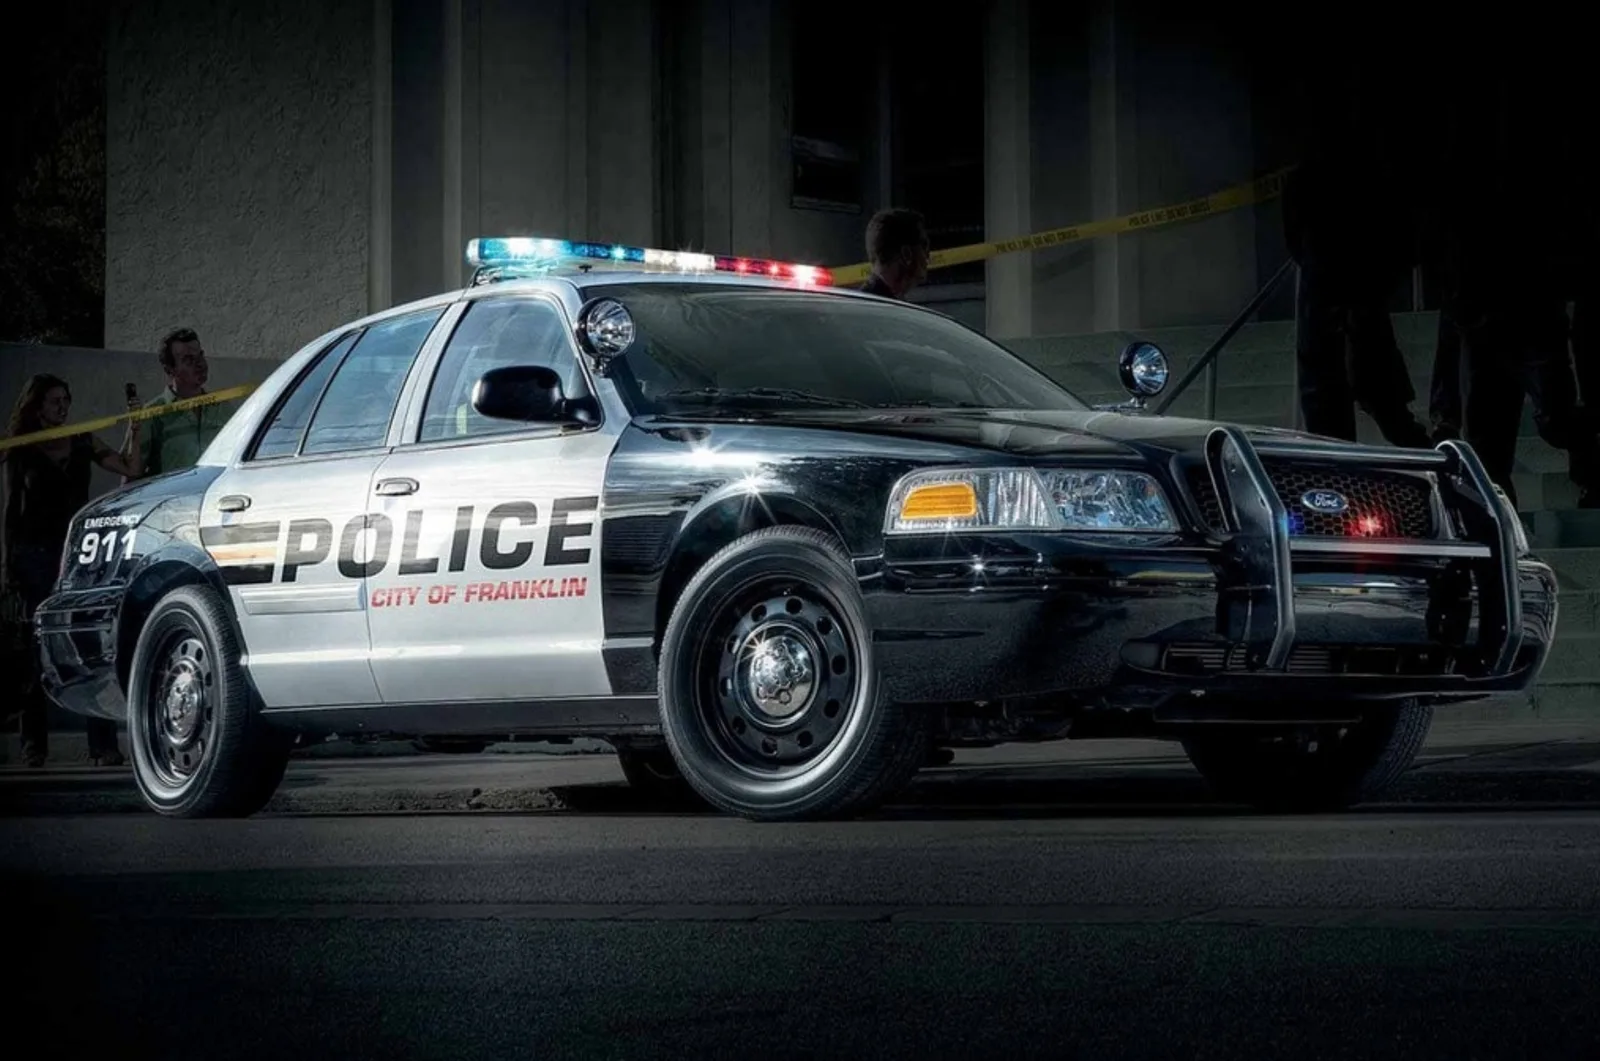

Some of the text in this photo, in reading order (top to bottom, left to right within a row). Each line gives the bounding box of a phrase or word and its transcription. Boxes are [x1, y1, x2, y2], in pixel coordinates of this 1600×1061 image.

[1315, 494, 1338, 506] Ford
[84, 514, 142, 529] EMERGENCY
[79, 529, 138, 564] 911
[280, 495, 599, 583] POLICE
[371, 577, 588, 608] CITY OF FRANKLIN
